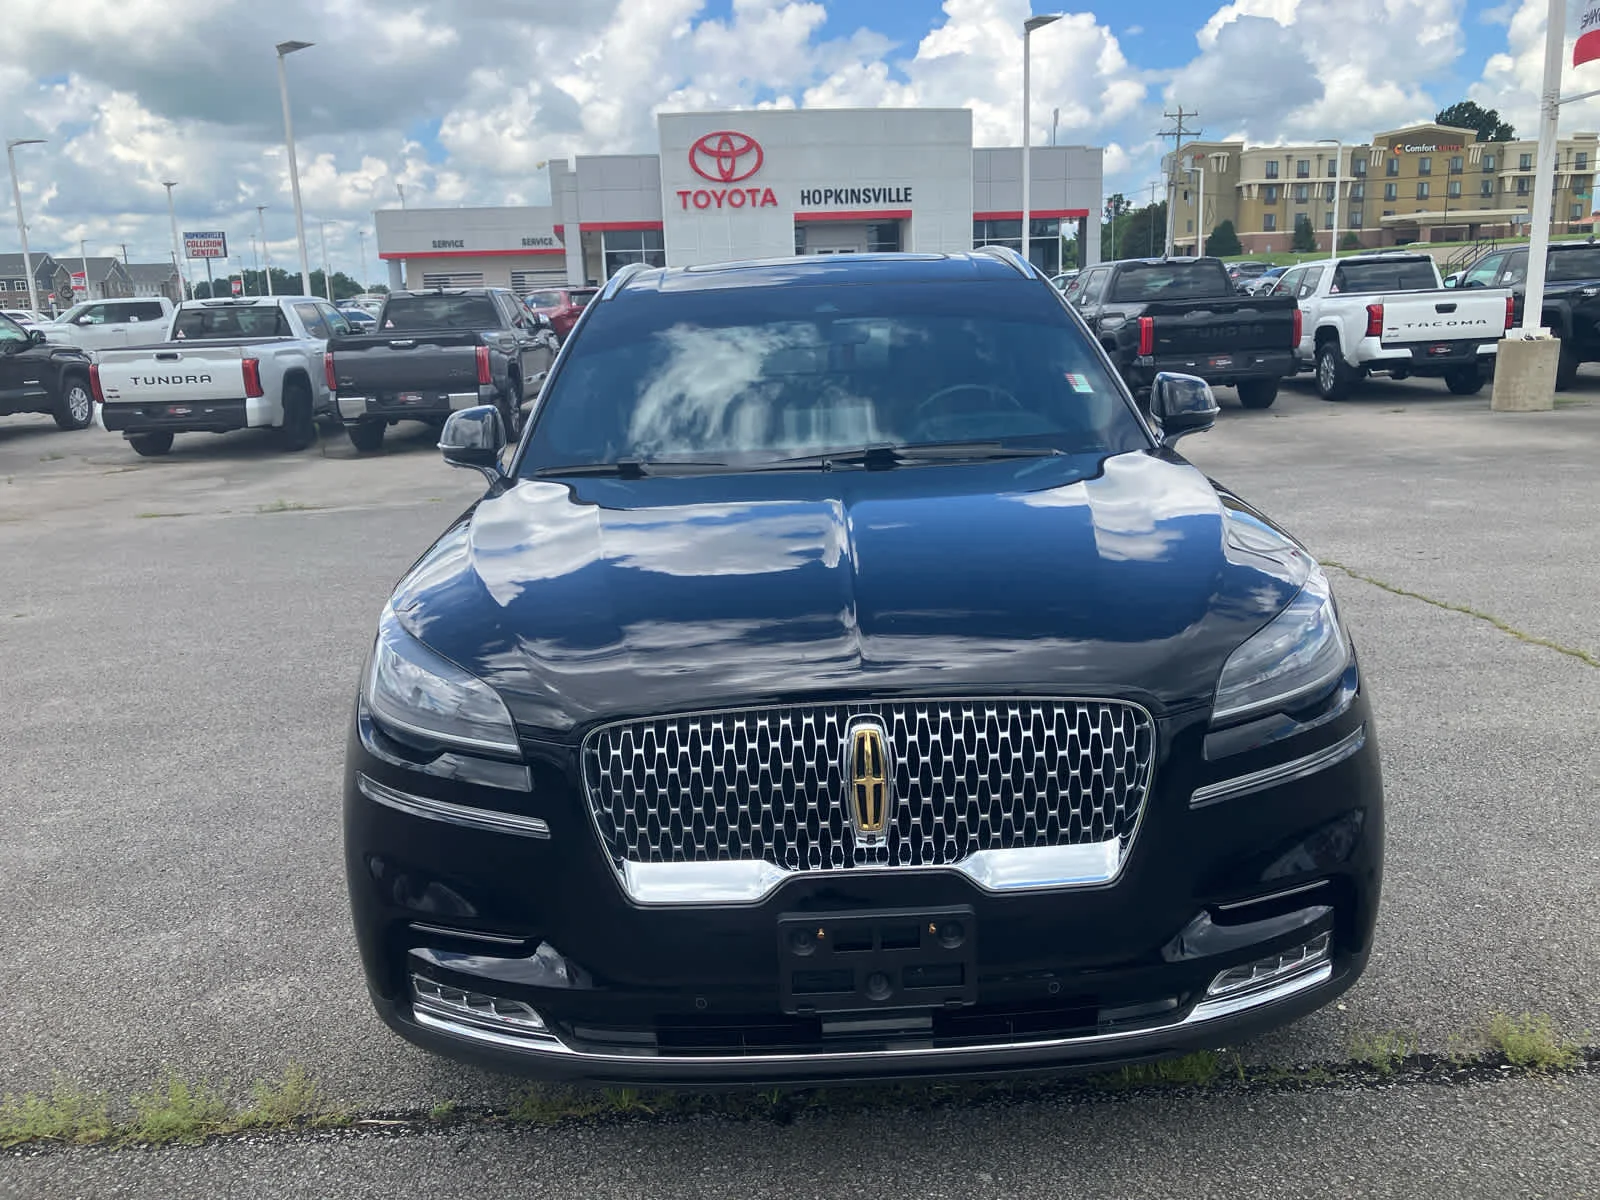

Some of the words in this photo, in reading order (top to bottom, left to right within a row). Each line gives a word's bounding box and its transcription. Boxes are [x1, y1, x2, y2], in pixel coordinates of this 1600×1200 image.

[1405, 143, 1436, 153] Comfort
[676, 187, 778, 210] TOYOTA
[800, 187, 913, 206] HOPKINSVILLE
[186, 240, 223, 248] COLLISION
[432, 239, 465, 249] SERVICE
[521, 237, 553, 247] SERVICE
[191, 249, 219, 257] CENTER
[1403, 319, 1488, 329] TACOMA
[129, 374, 212, 386] TUNDRA
